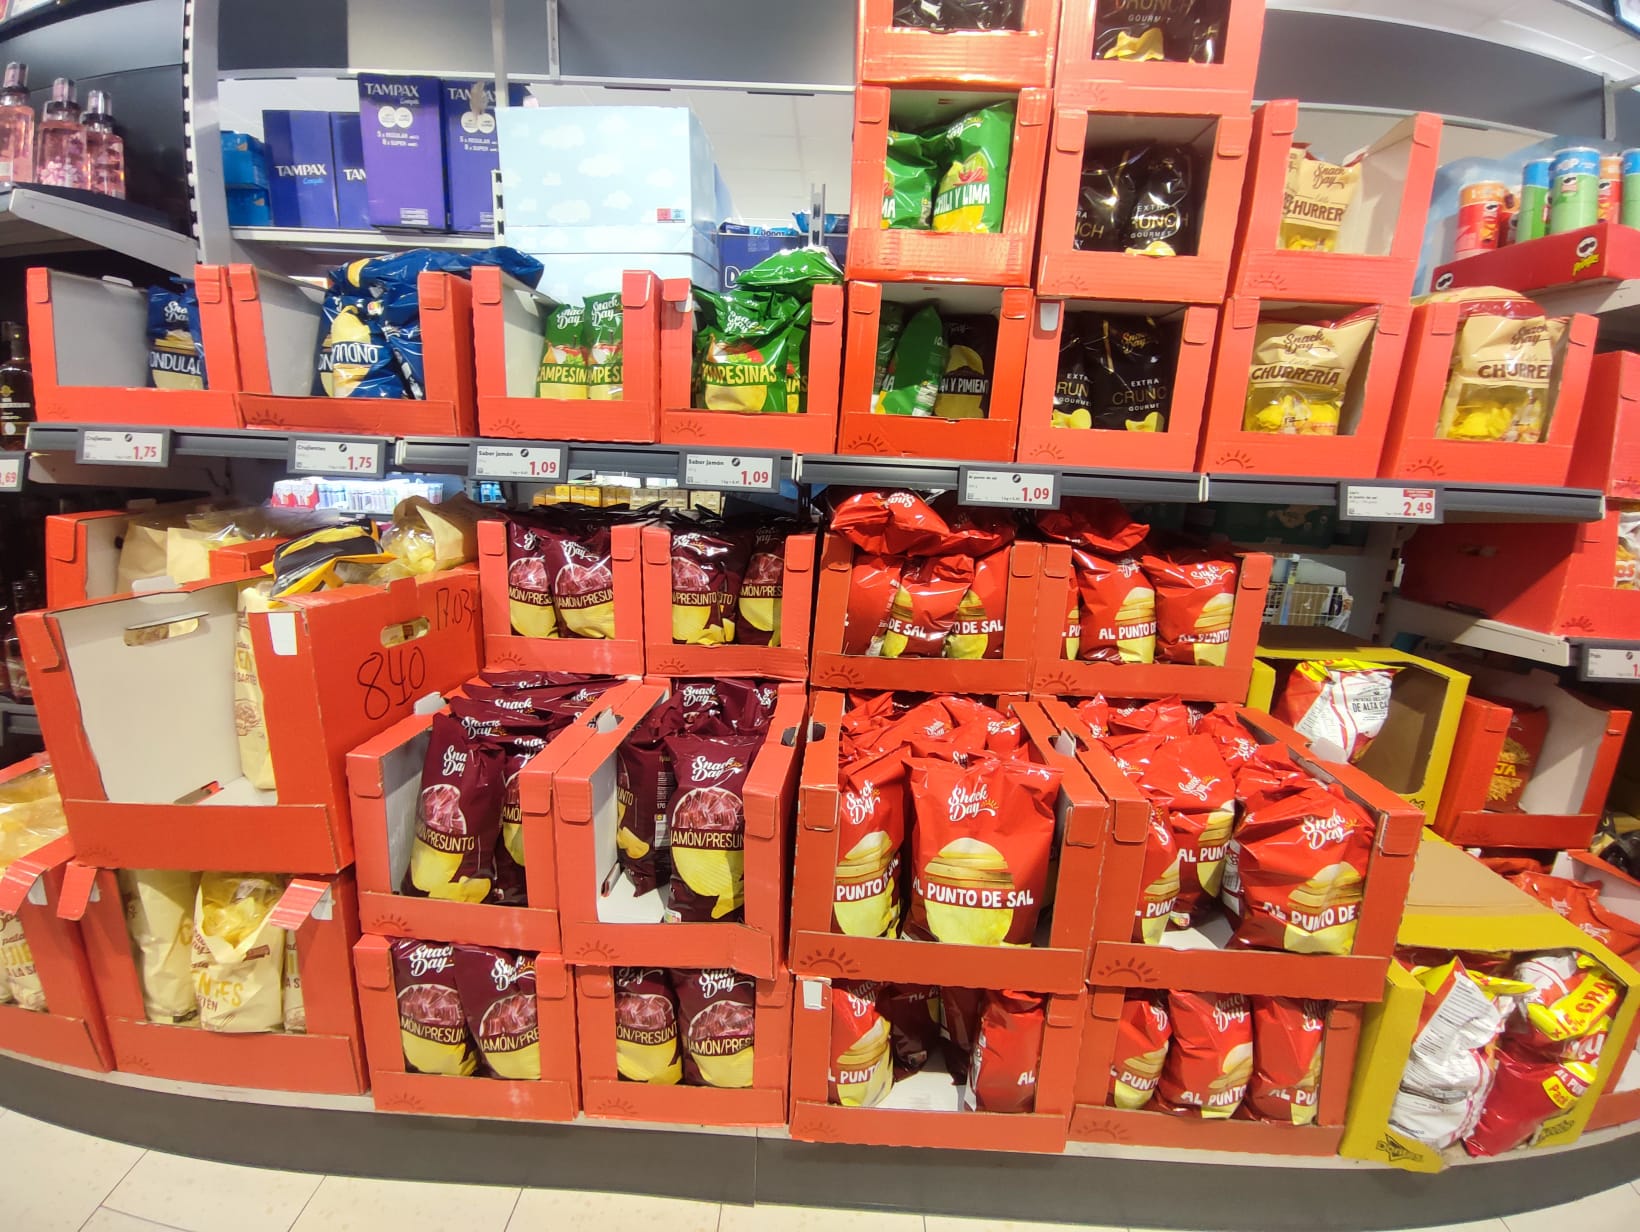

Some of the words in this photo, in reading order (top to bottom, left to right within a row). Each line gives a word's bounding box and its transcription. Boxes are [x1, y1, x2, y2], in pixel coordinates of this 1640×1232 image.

[1128, 15, 1171, 23] GOURMT
[364, 82, 420, 98] TAMPAX
[274, 163, 327, 177] TAMPAX
[955, 188, 962, 208] Y
[962, 183, 991, 206] LIMA
[1287, 199, 1345, 222] HURRER
[1130, 230, 1172, 239] GOURMET
[1283, 328, 1325, 345] Snack
[1130, 378, 1160, 388] EXTRA
[133, 445, 158, 460] 1.75
[347, 455, 373, 471] 1.75
[529, 461, 557, 476] 1.09
[741, 470, 769, 486] 1.09
[1021, 487, 1050, 502] 1.09
[1403, 501, 1433, 517] 2.49
[903, 624, 927, 638] SAL
[961, 620, 979, 634] DE
[981, 618, 1004, 634] SAL
[1098, 627, 1116, 641] AL
[1118, 622, 1150, 641] PUNTO
[357, 645, 427, 721] 840
[683, 685, 717, 699] Snack
[684, 693, 718, 707] Day
[1352, 702, 1361, 713] DE
[1362, 701, 1379, 711] ALTA
[462, 715, 502, 729] Snack
[467, 725, 500, 740] Day
[948, 782, 988, 814] Snack
[949, 799, 997, 822] Day
[1302, 807, 1346, 834] Snack
[1308, 828, 1354, 850] Day
[1177, 848, 1197, 863] AL
[836, 878, 882, 901] PUNTO
[926, 881, 978, 906] PUNTO
[981, 890, 1003, 908] DE
[1006, 889, 1034, 907] SAL
[1291, 908, 1335, 931] PUNTO
[1337, 904, 1356, 922] DE
[410, 956, 455, 977] Day
[702, 976, 755, 999] Day
[1017, 1069, 1036, 1086] AL
[1180, 1090, 1203, 1106] AL
